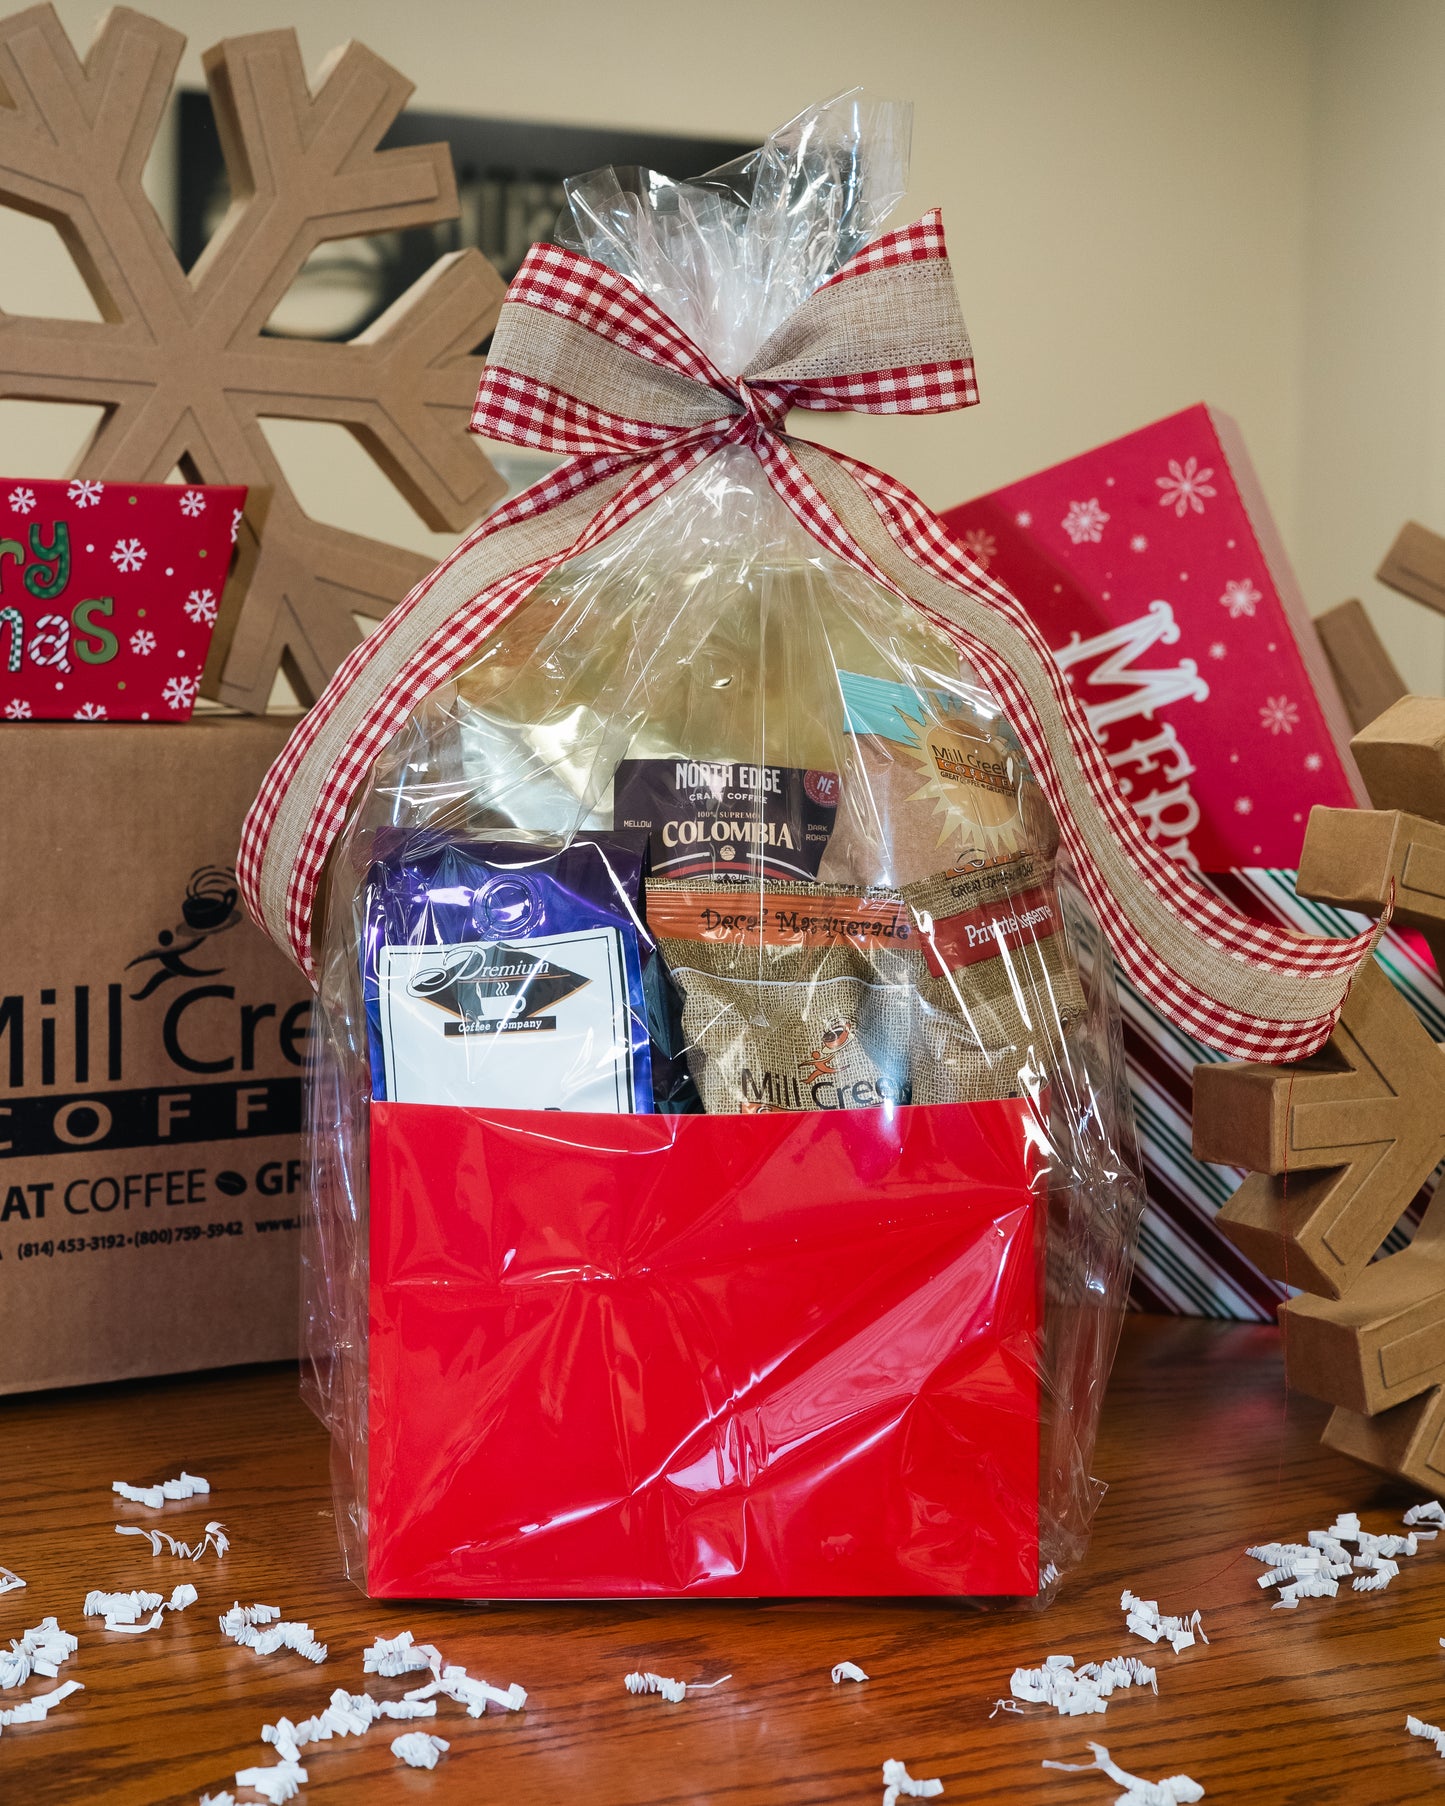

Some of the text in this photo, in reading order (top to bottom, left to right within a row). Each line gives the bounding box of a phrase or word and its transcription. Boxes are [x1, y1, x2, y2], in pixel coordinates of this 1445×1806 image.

[931, 744, 1008, 776] Mill Creek
[675, 762, 734, 790] NORTH
[739, 766, 782, 794] EDGE
[816, 775, 835, 795] NE
[941, 771, 960, 782] GREAT
[689, 792, 768, 805] CRAFT COFFEE
[623, 820, 652, 828] MELLOW
[662, 819, 794, 850] COLOMBIA
[805, 833, 830, 842] ROAST
[807, 823, 828, 832] DARK
[701, 908, 910, 940] Decaf Masquerade
[406, 945, 549, 998] Premium
[458, 1018, 543, 1034] Coffee Company
[741, 1068, 800, 1108] Mill
[0, 1086, 269, 1151] OFF
[64, 1168, 208, 1216] COFFEE
[17, 1240, 54, 1261] (814)
[174, 1221, 244, 1243] 759-5942
